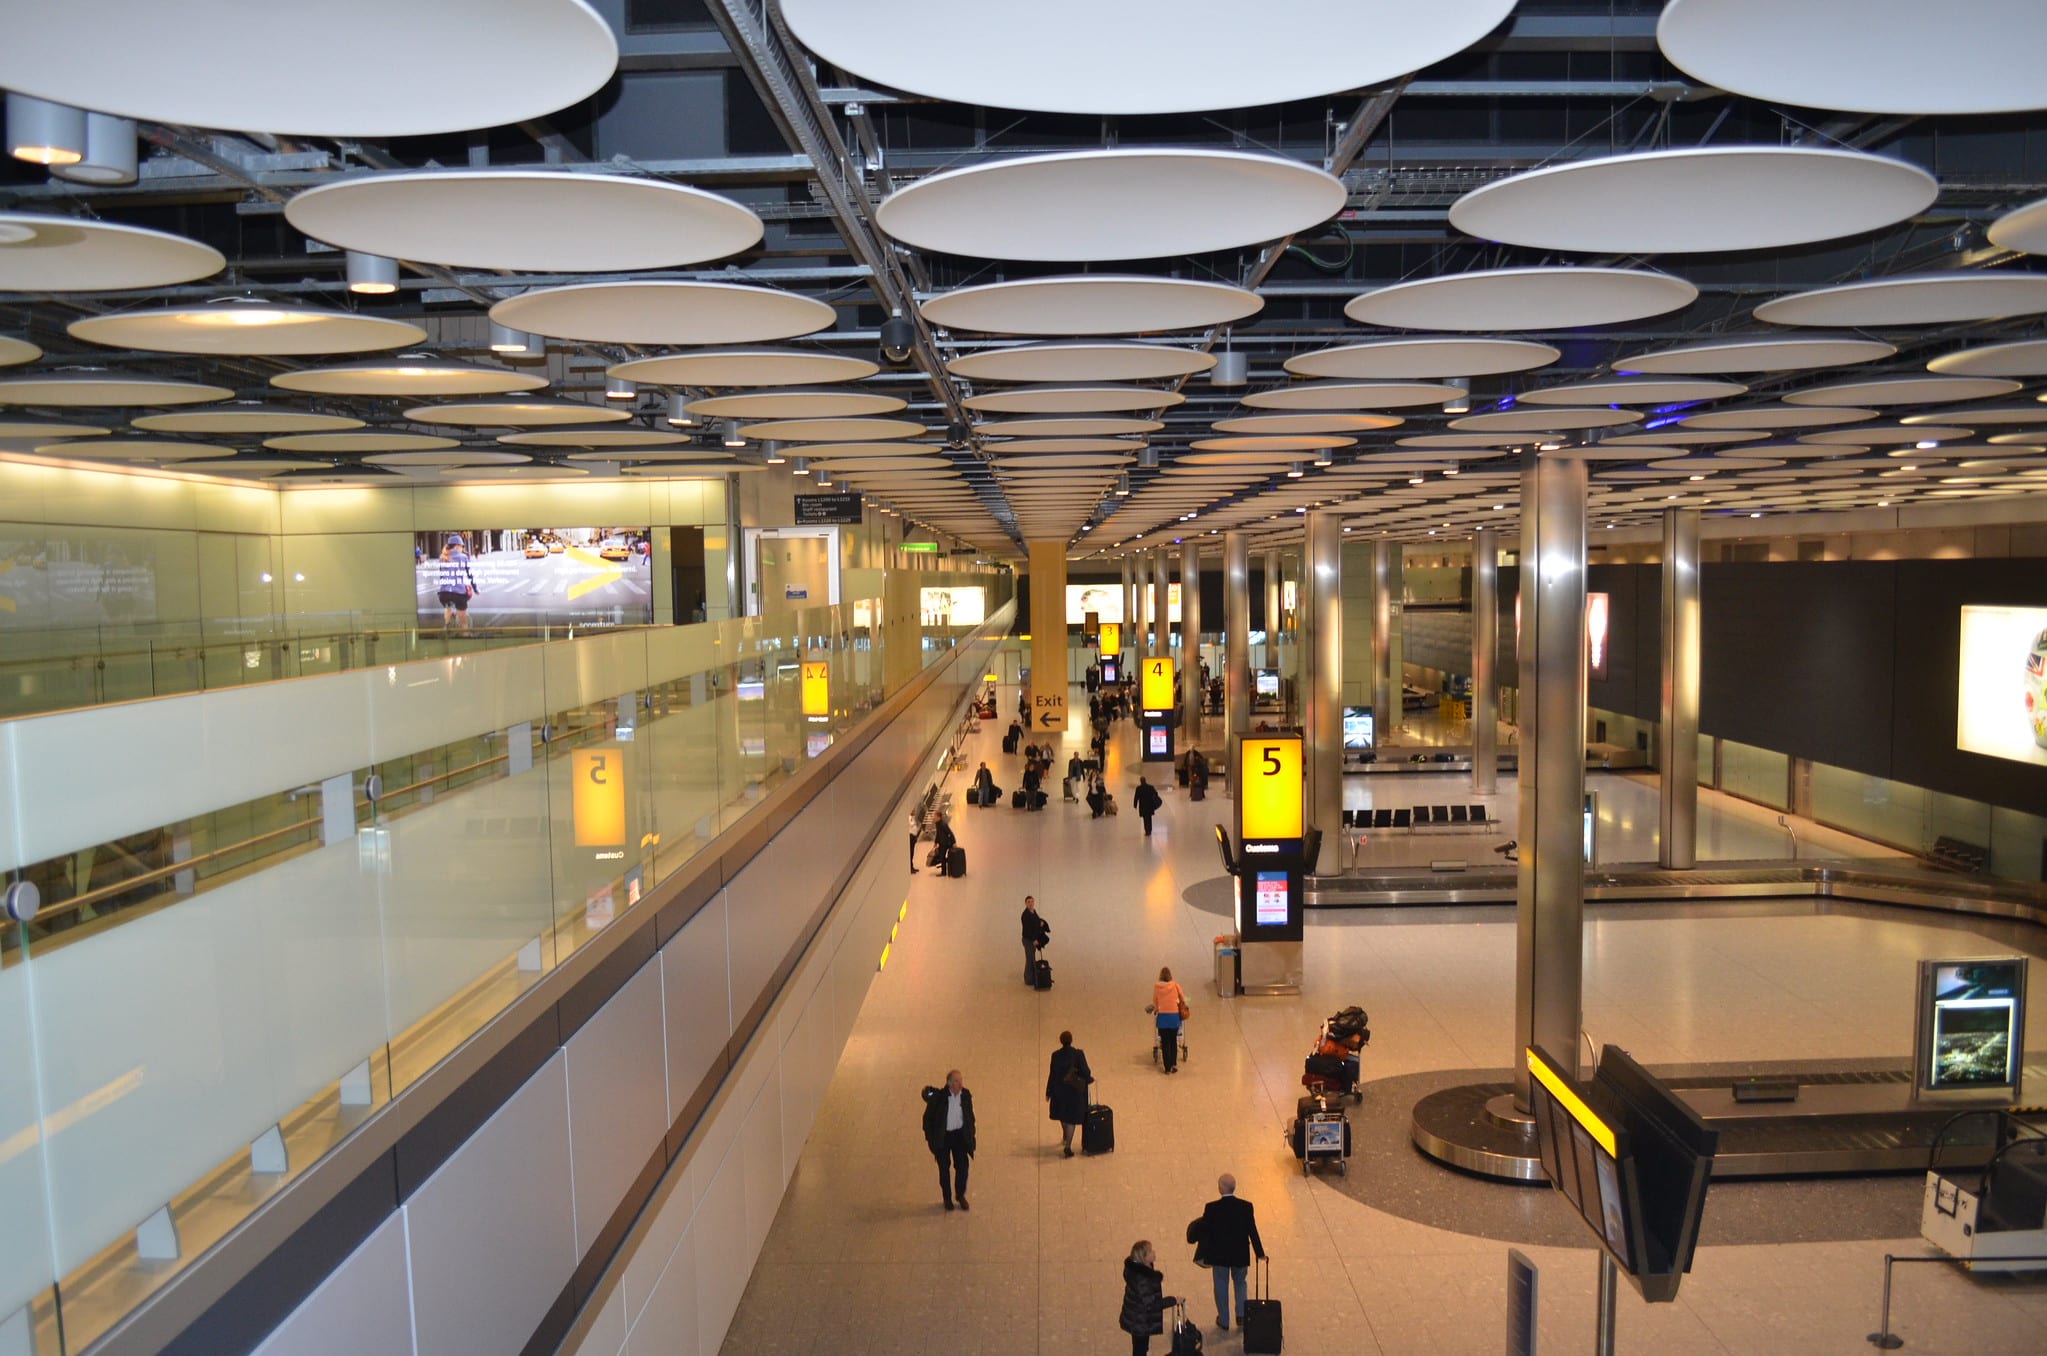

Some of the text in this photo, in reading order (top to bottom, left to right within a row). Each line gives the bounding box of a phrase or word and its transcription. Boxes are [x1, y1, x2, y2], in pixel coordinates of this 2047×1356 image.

[439, 578, 456, 586] doing
[1106, 626, 1113, 636] 3
[1153, 662, 1164, 677] 4
[1036, 694, 1063, 707] Exit
[1263, 747, 1281, 776] 5
